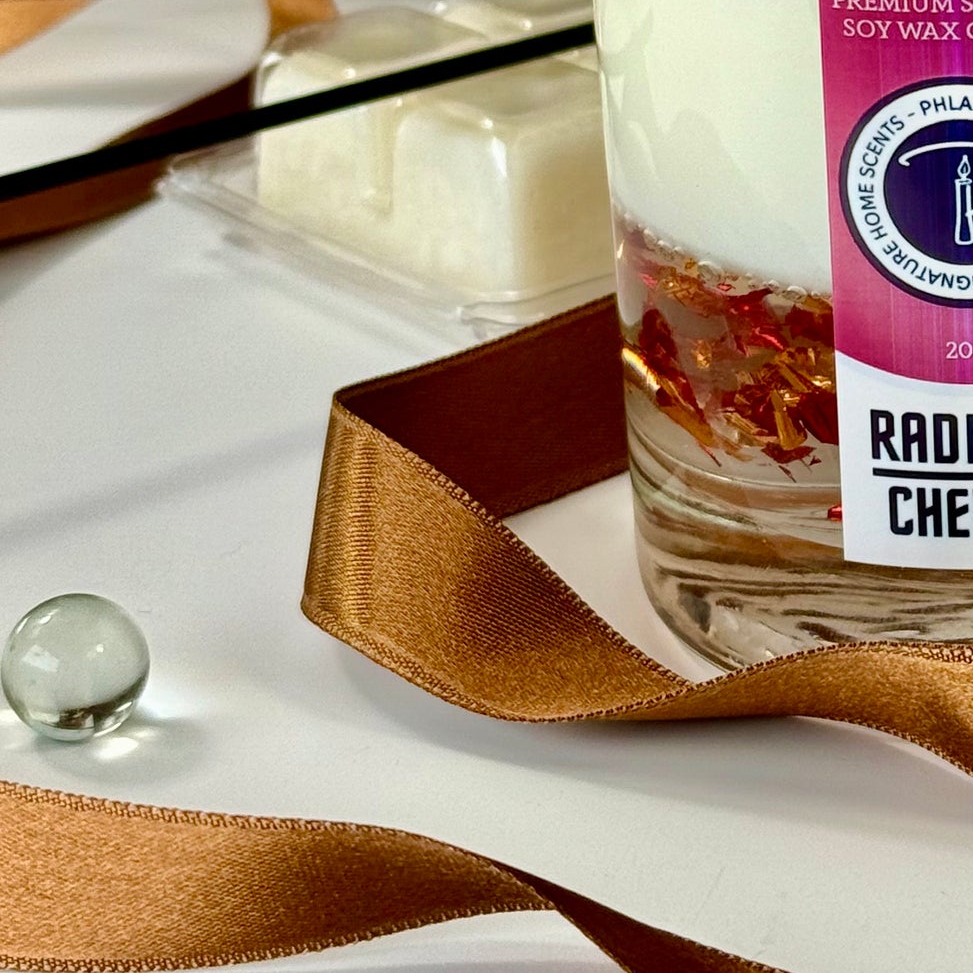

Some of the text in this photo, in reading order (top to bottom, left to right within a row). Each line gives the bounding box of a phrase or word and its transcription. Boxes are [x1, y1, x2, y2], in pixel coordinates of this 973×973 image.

[842, 19, 892, 40] SOY
[898, 22, 961, 41] WAX
[859, 115, 905, 179] SCENTS
[858, 183, 888, 241] HOME
